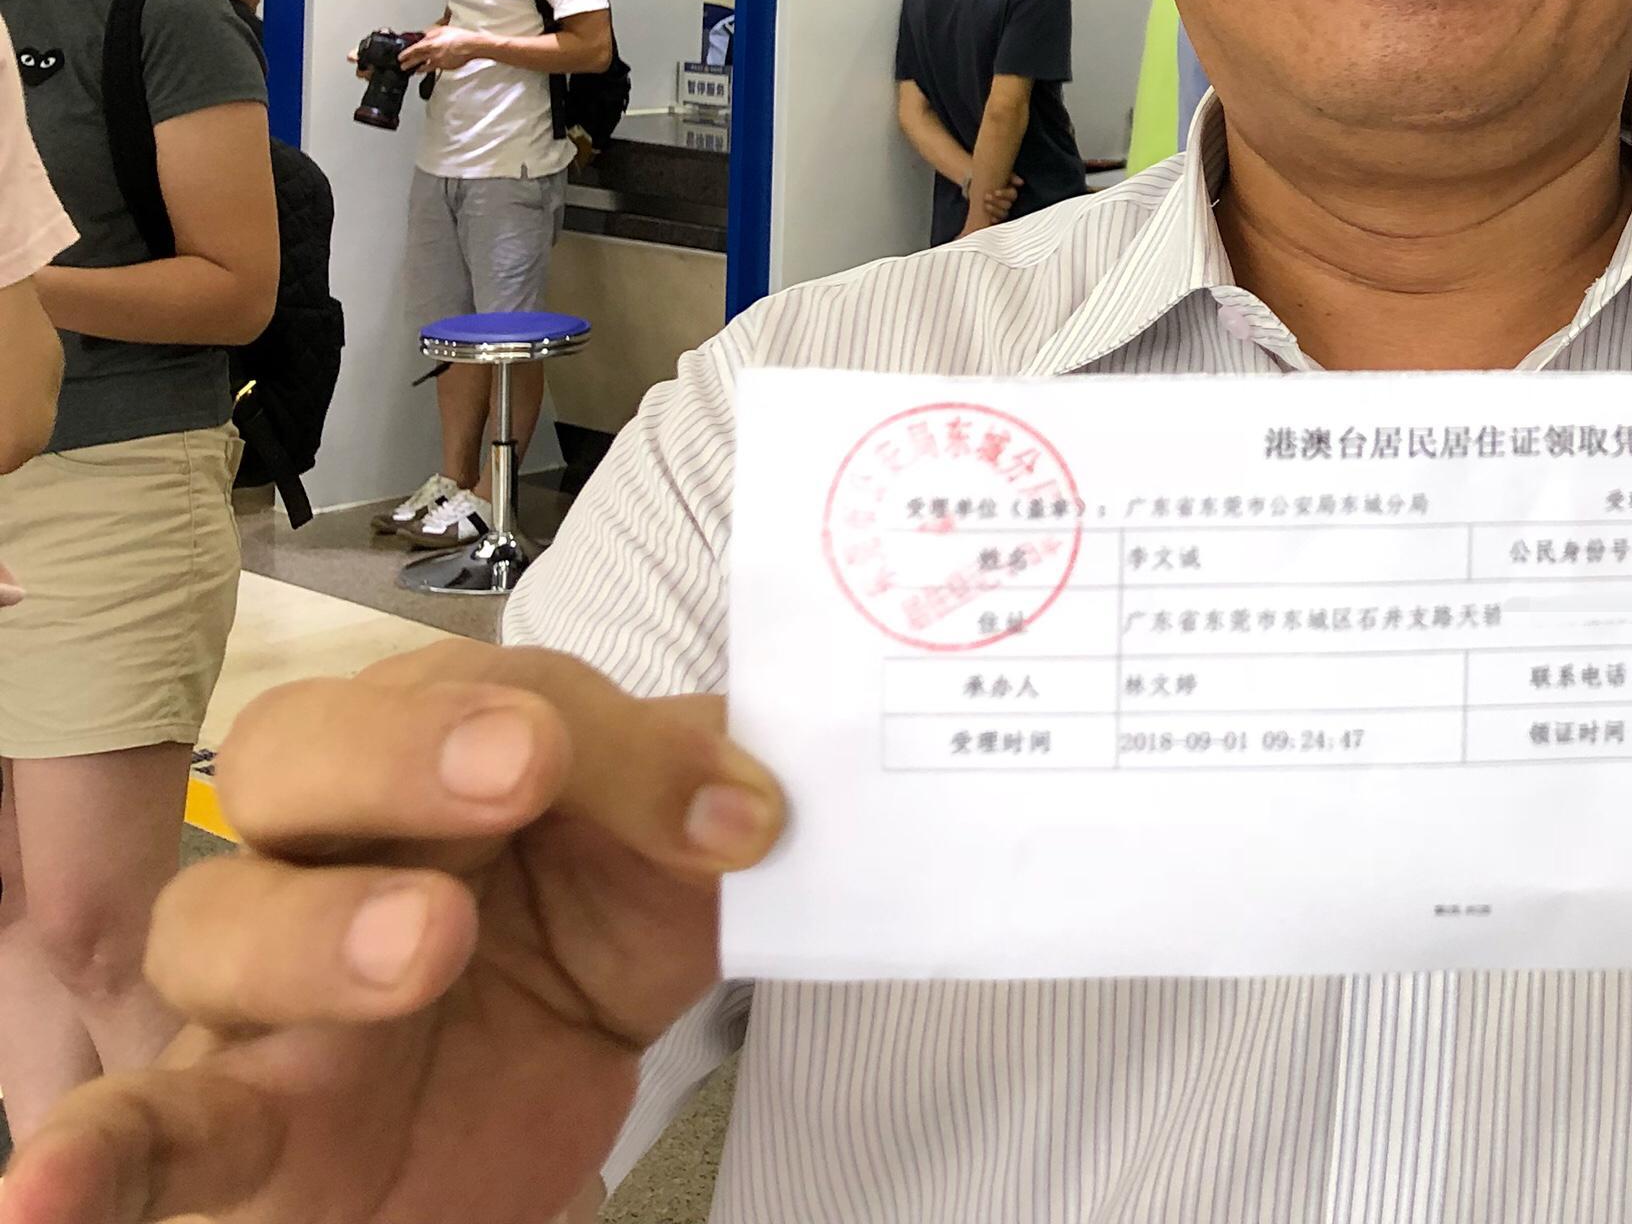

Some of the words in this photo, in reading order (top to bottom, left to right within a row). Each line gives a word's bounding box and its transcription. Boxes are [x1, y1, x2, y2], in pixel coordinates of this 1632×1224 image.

[962, 673, 1040, 699] 承办人
[1530, 662, 1626, 688] 联系电话
[950, 729, 1052, 754] 受理时间
[1119, 730, 1248, 753] 2018-09-01
[1530, 720, 1625, 744] 领证时间
